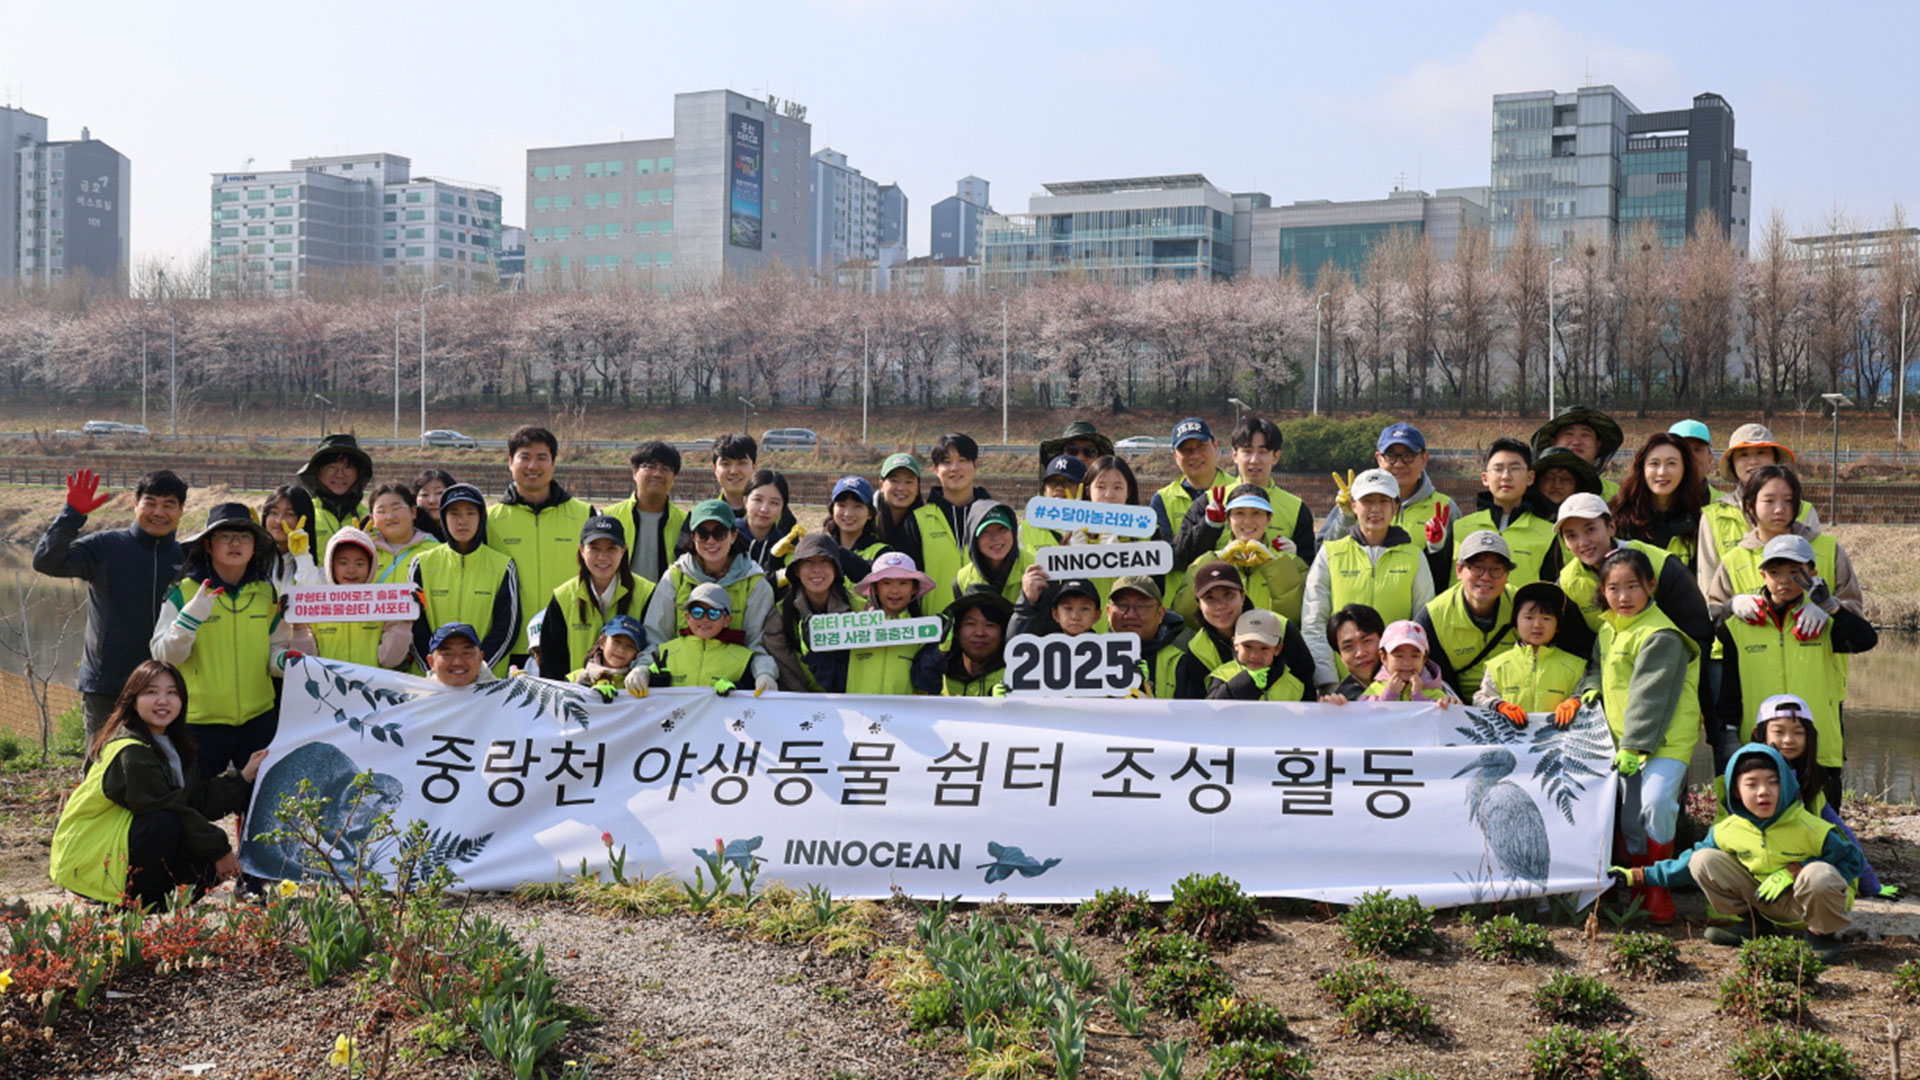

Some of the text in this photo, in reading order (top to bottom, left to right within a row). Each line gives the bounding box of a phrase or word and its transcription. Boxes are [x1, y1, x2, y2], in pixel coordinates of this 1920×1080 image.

[88, 217, 101, 227] 101
[1176, 421, 1202, 438] JEEP
[1034, 505, 1134, 528] #수달아놀러와
[1048, 549, 1161, 572] INNOCEAN
[295, 592, 327, 603] #쉼터
[329, 590, 373, 602] 히어로즈
[295, 602, 410, 616] 야생동물쉼터 서포터
[812, 612, 883, 631] 쉼터 FLEX!
[813, 632, 840, 647] 환경
[844, 630, 872, 644] 사랑
[1012, 641, 1134, 690] 2025
[416, 734, 1425, 819] 중랑천 야생동물 쉼터 조성 활동
[784, 839, 962, 870] INNOCEAN
